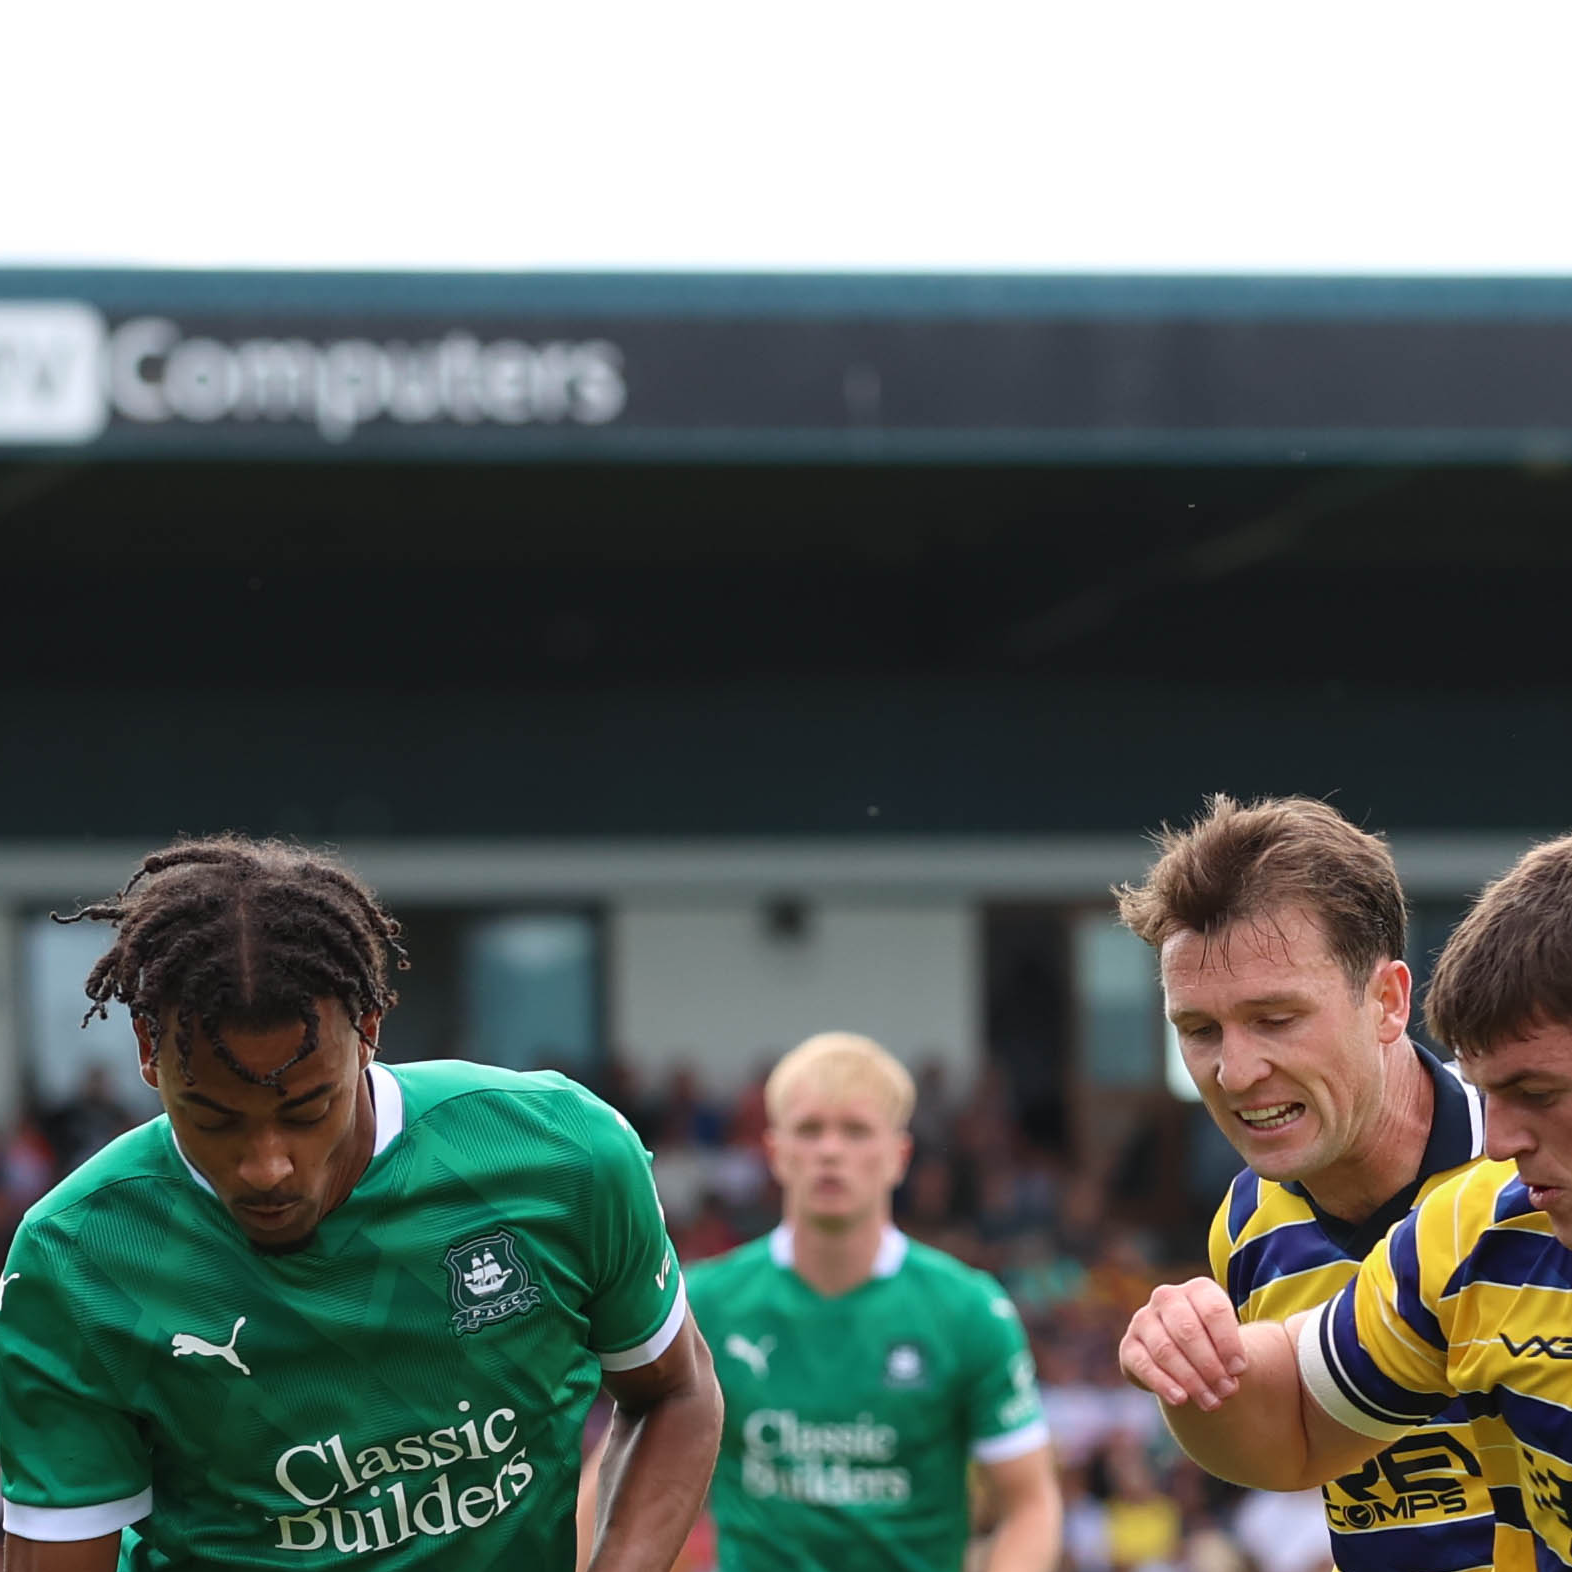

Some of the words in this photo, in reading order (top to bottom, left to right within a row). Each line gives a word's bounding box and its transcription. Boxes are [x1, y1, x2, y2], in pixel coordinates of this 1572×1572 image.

[106, 317, 627, 443] Computers
[275, 1400, 517, 1506] Classic
[743, 1408, 899, 1462] Classic
[273, 1446, 534, 1555] Builders
[741, 1452, 912, 1505] Builders
[1325, 1487, 1468, 1530] COMPS
